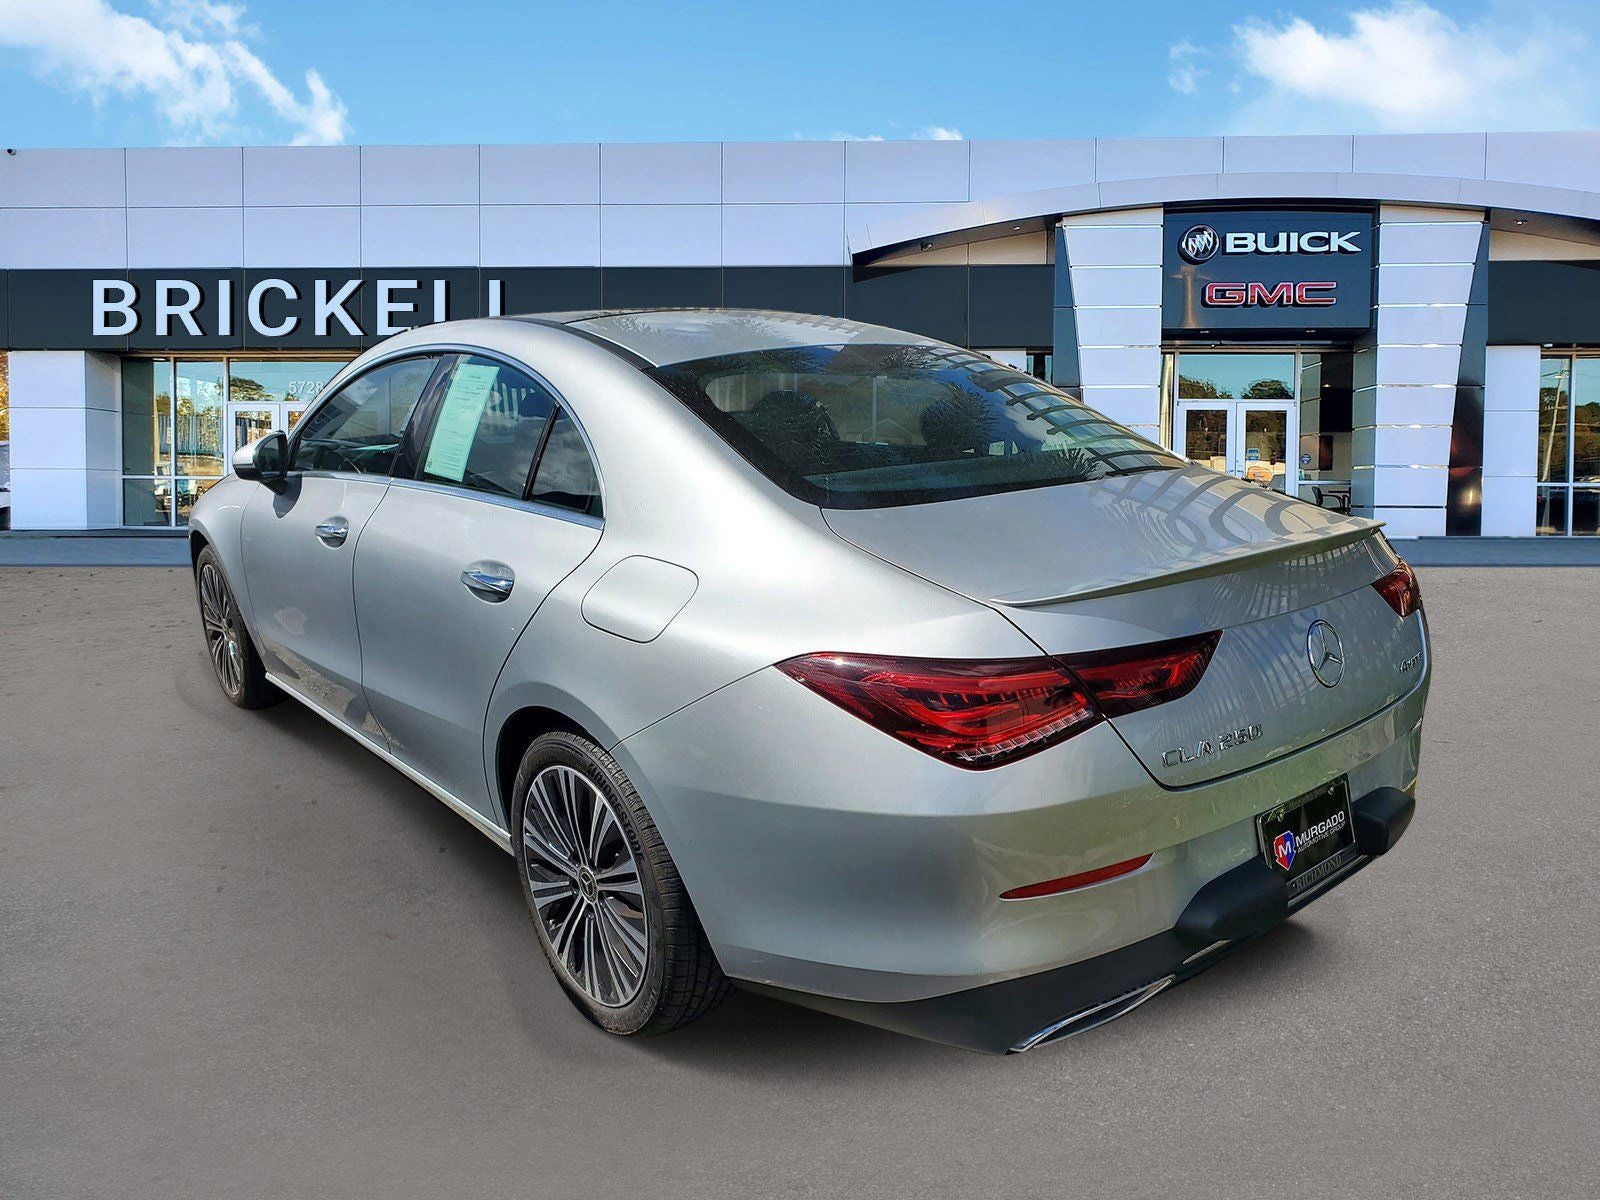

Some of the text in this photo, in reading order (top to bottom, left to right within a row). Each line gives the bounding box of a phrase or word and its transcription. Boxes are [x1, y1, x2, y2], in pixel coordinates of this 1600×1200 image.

[1226, 231, 1361, 253] BUICK
[1206, 282, 1337, 305] GMC
[1162, 724, 1263, 768] CLA 250
[587, 762, 646, 861] BRIDGESTONE
[1295, 810, 1345, 848] MURGADO
[1297, 820, 1347, 854] AUTOMOTIVE GROUP
[1278, 840, 1292, 858] M
[1296, 855, 1342, 890] RICHMOND
